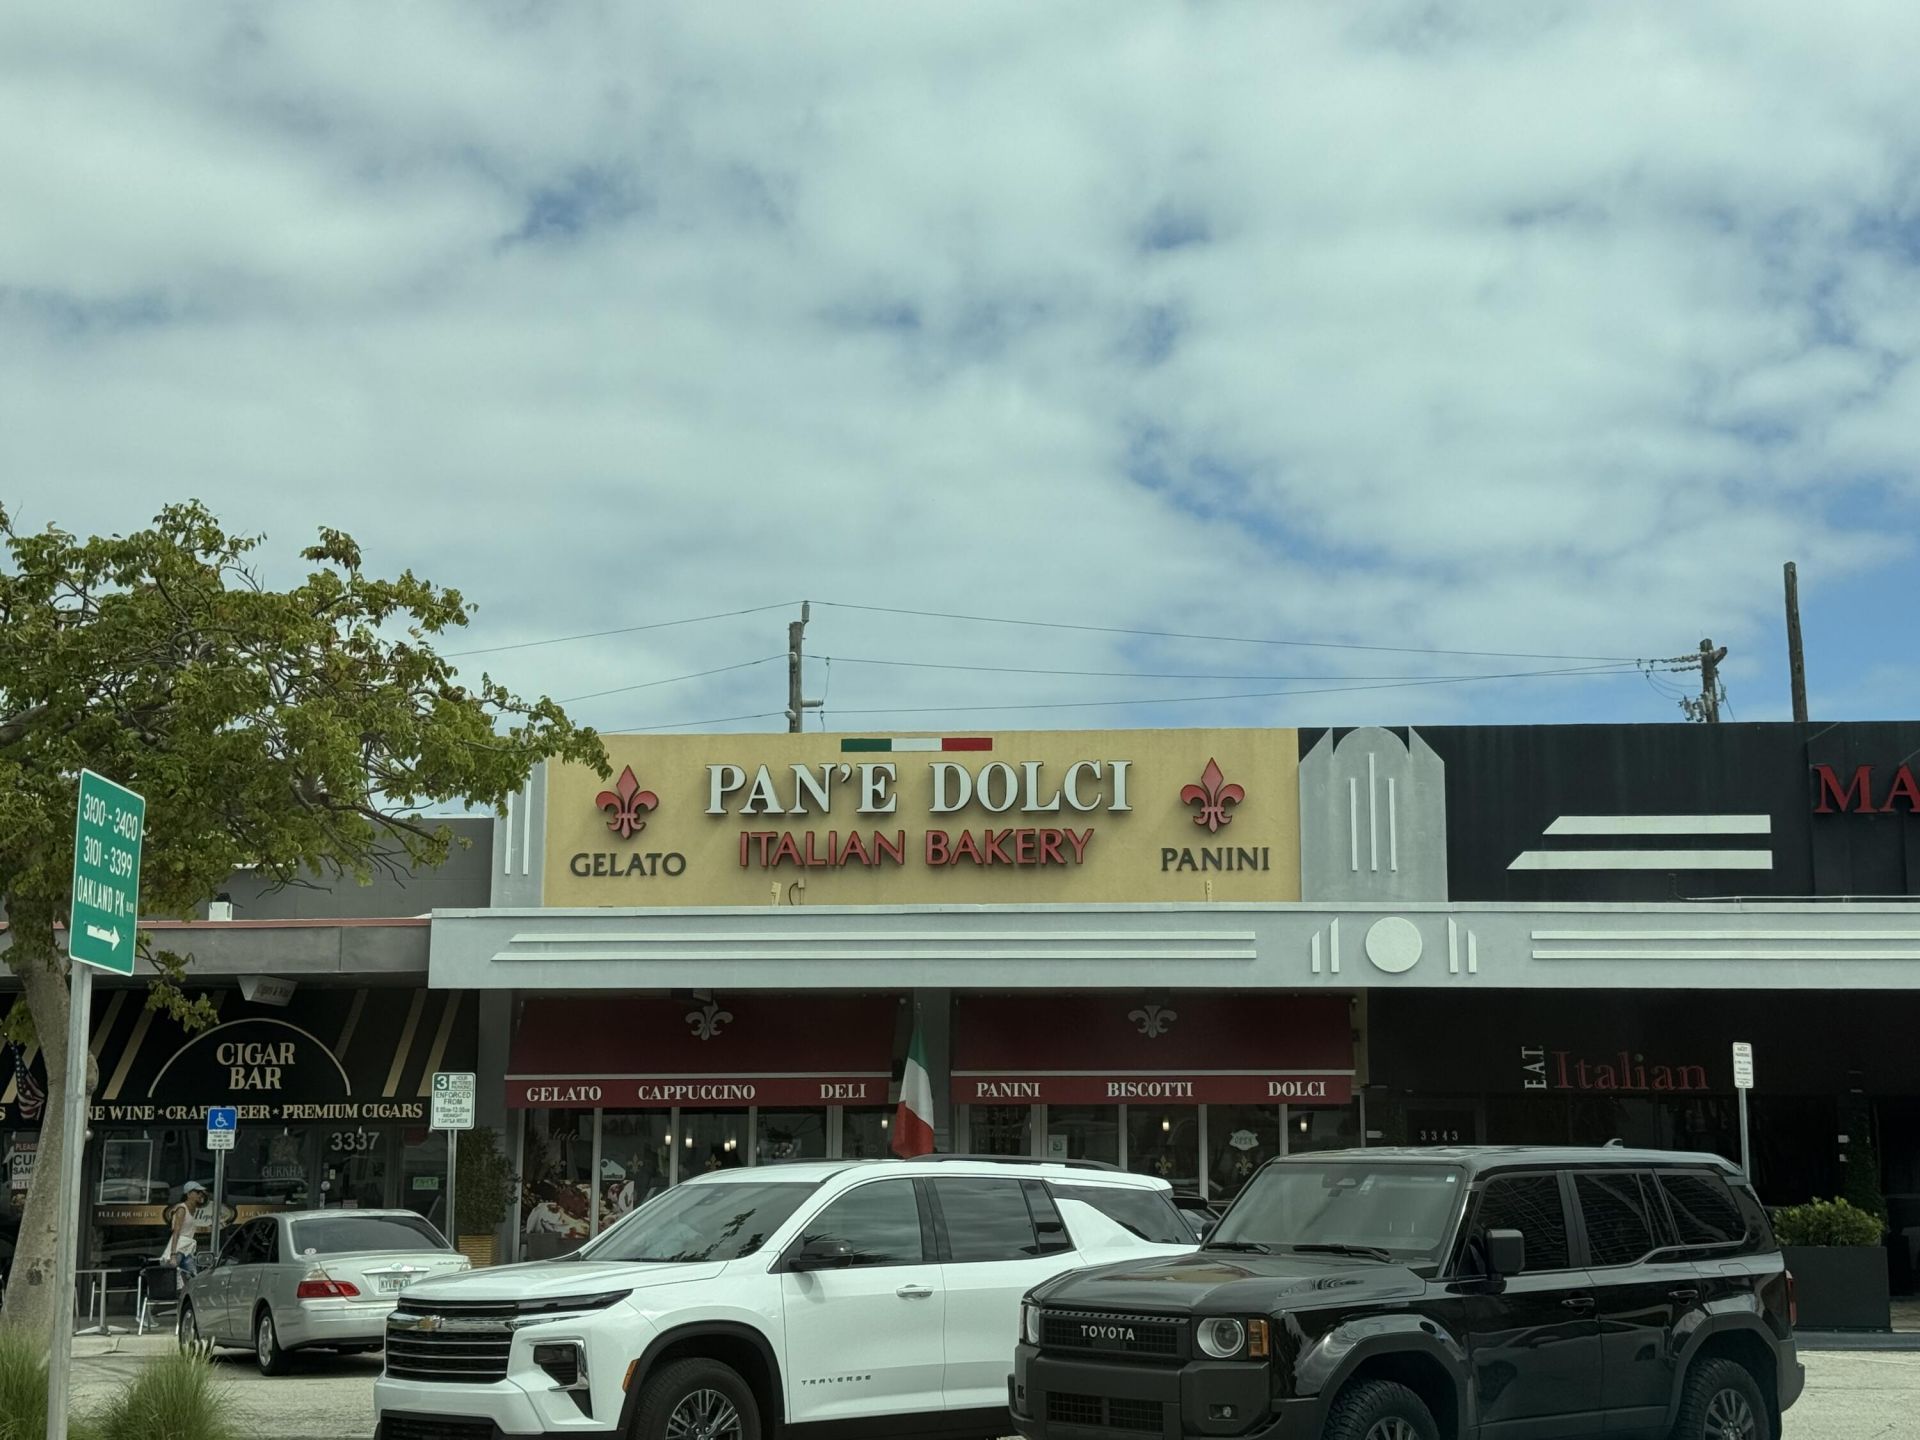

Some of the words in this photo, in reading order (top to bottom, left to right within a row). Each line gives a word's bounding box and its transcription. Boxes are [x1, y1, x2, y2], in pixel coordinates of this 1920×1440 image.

[704, 763, 897, 815] PAN'E
[928, 760, 1133, 813] DOLCI
[83, 793, 106, 827] 3100
[113, 807, 138, 842] 3400
[83, 835, 102, 867] 3101
[109, 847, 133, 879] 3399
[739, 830, 906, 867] ITALIAN
[925, 828, 1095, 866] BAKERY
[570, 852, 686, 877] GELATO
[1160, 847, 1270, 872] PANINI
[77, 875, 113, 913] OAKLAND
[115, 889, 125, 918] PK
[216, 1042, 296, 1065] CIGAR
[228, 1067, 282, 1090] BAR
[436, 1075, 448, 1090] 3
[1551, 1051, 1711, 1091] Italian
[526, 1086, 602, 1102] GELATO
[638, 1084, 756, 1101] CAPPUCCINO
[820, 1083, 866, 1099] DELI
[976, 1082, 1040, 1098] PANINI
[1107, 1081, 1193, 1098] BISCOTTI
[1268, 1081, 1326, 1097] DOLCI
[110, 1106, 154, 1121] WINE
[165, 1106, 209, 1120] CRAF
[236, 1105, 270, 1119] EER
[281, 1104, 359, 1119] PREMIUM
[362, 1103, 423, 1118] CIGARS
[331, 1132, 380, 1151] 3337
[1080, 1324, 1135, 1340] TOYOTA
[801, 1374, 871, 1385] TRAVERSE
